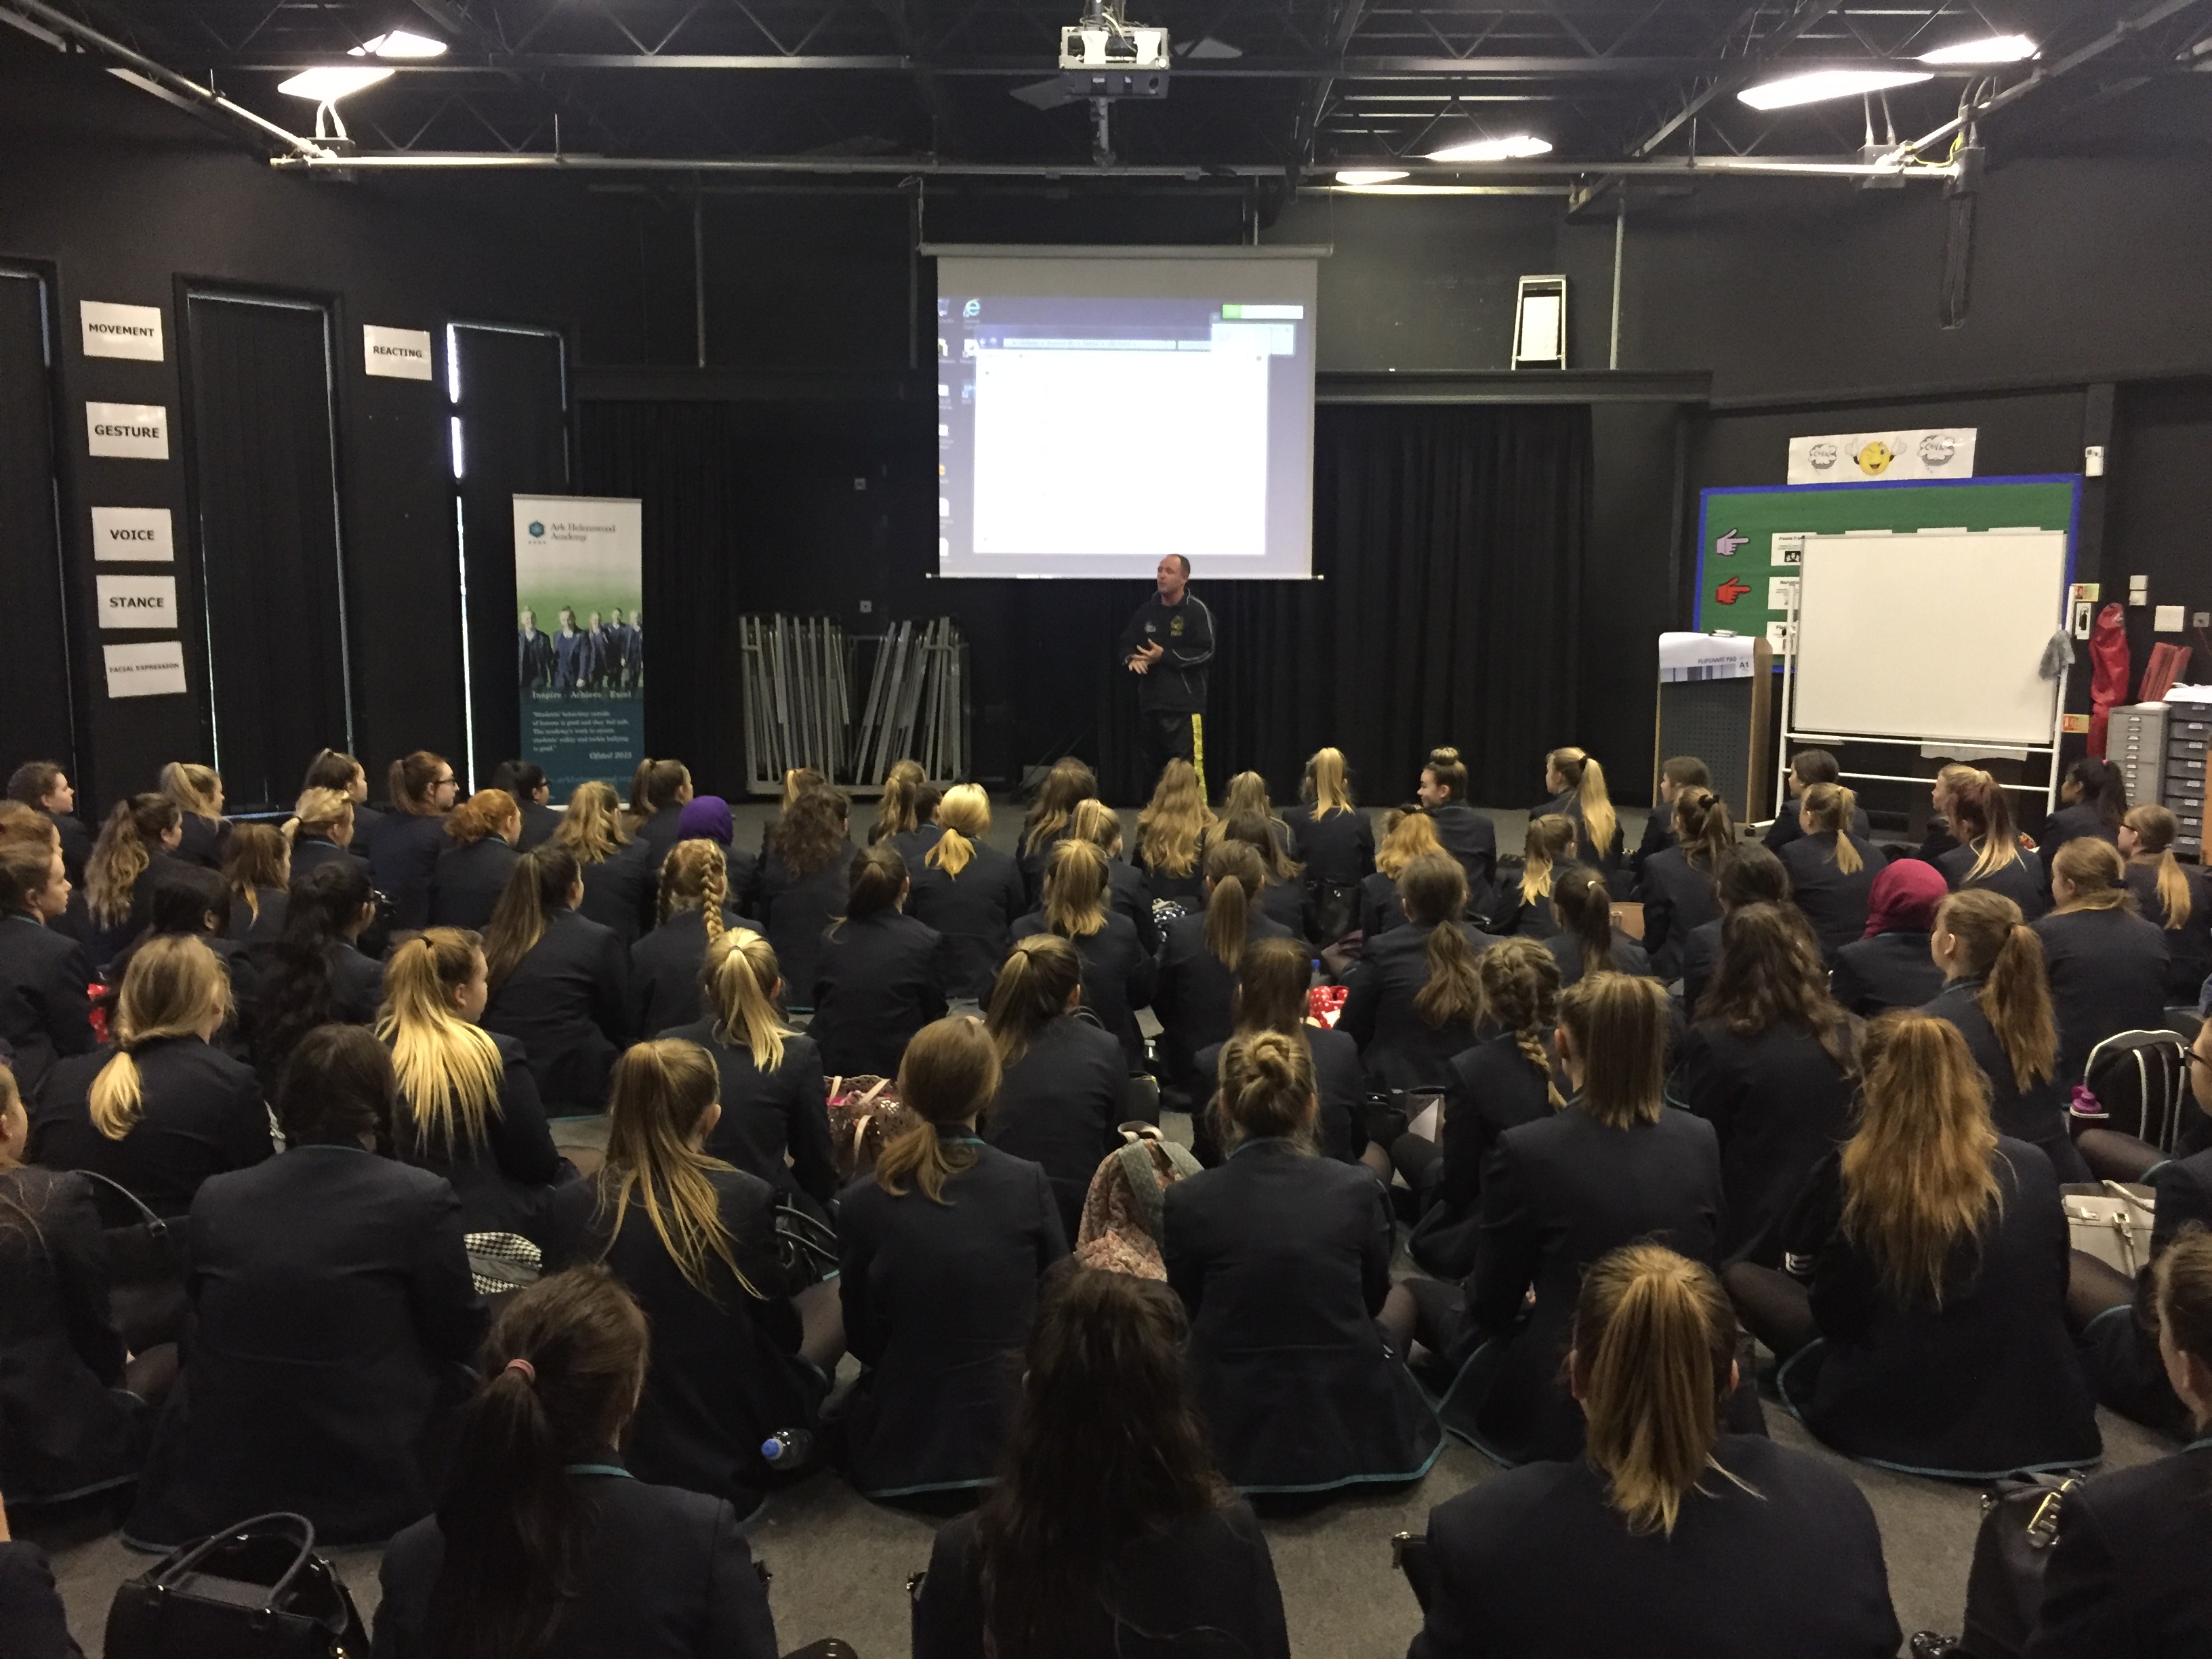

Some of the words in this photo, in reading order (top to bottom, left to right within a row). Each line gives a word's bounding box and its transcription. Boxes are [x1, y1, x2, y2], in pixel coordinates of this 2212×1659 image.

[89, 323, 155, 337] MOVEMENT
[373, 345, 423, 359] REACTING
[94, 424, 160, 438] GESTURE
[110, 529, 155, 540] VOICE
[109, 596, 164, 608] STANCE
